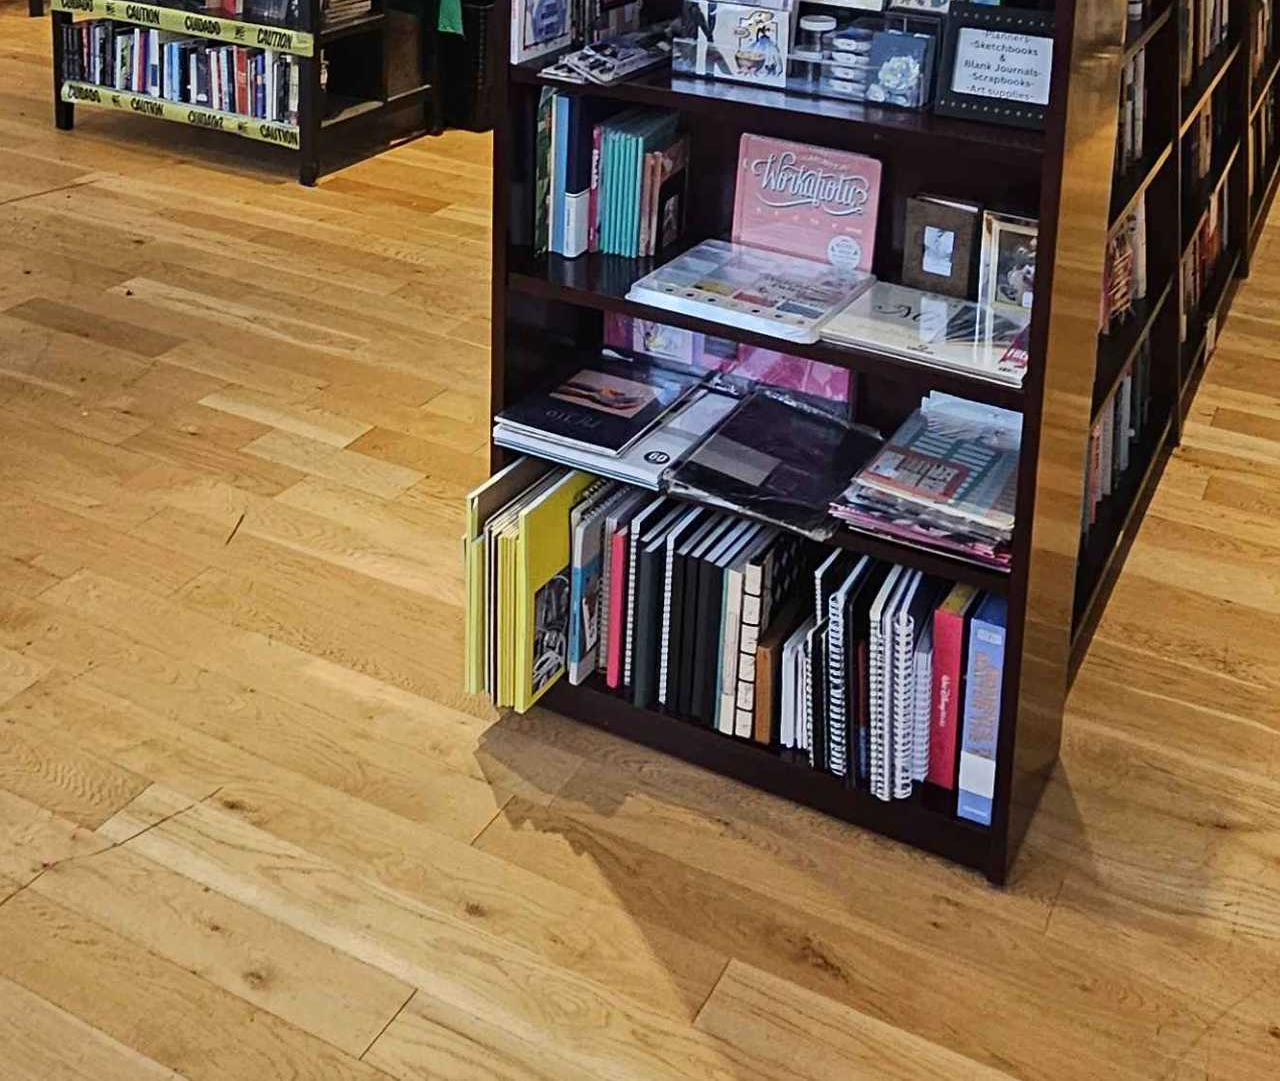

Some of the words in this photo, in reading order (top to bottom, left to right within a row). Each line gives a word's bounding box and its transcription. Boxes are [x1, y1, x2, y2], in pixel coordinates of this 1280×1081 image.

[126, 4, 160, 24] CAUTION
[184, 16, 221, 35] CUIDADO
[256, 28, 293, 50] CAUTION
[1000, 54, 1006, 62] &
[68, 84, 100, 103] CUIDADO
[130, 98, 164, 117] CAUTION
[259, 124, 298, 146] CAUTION
